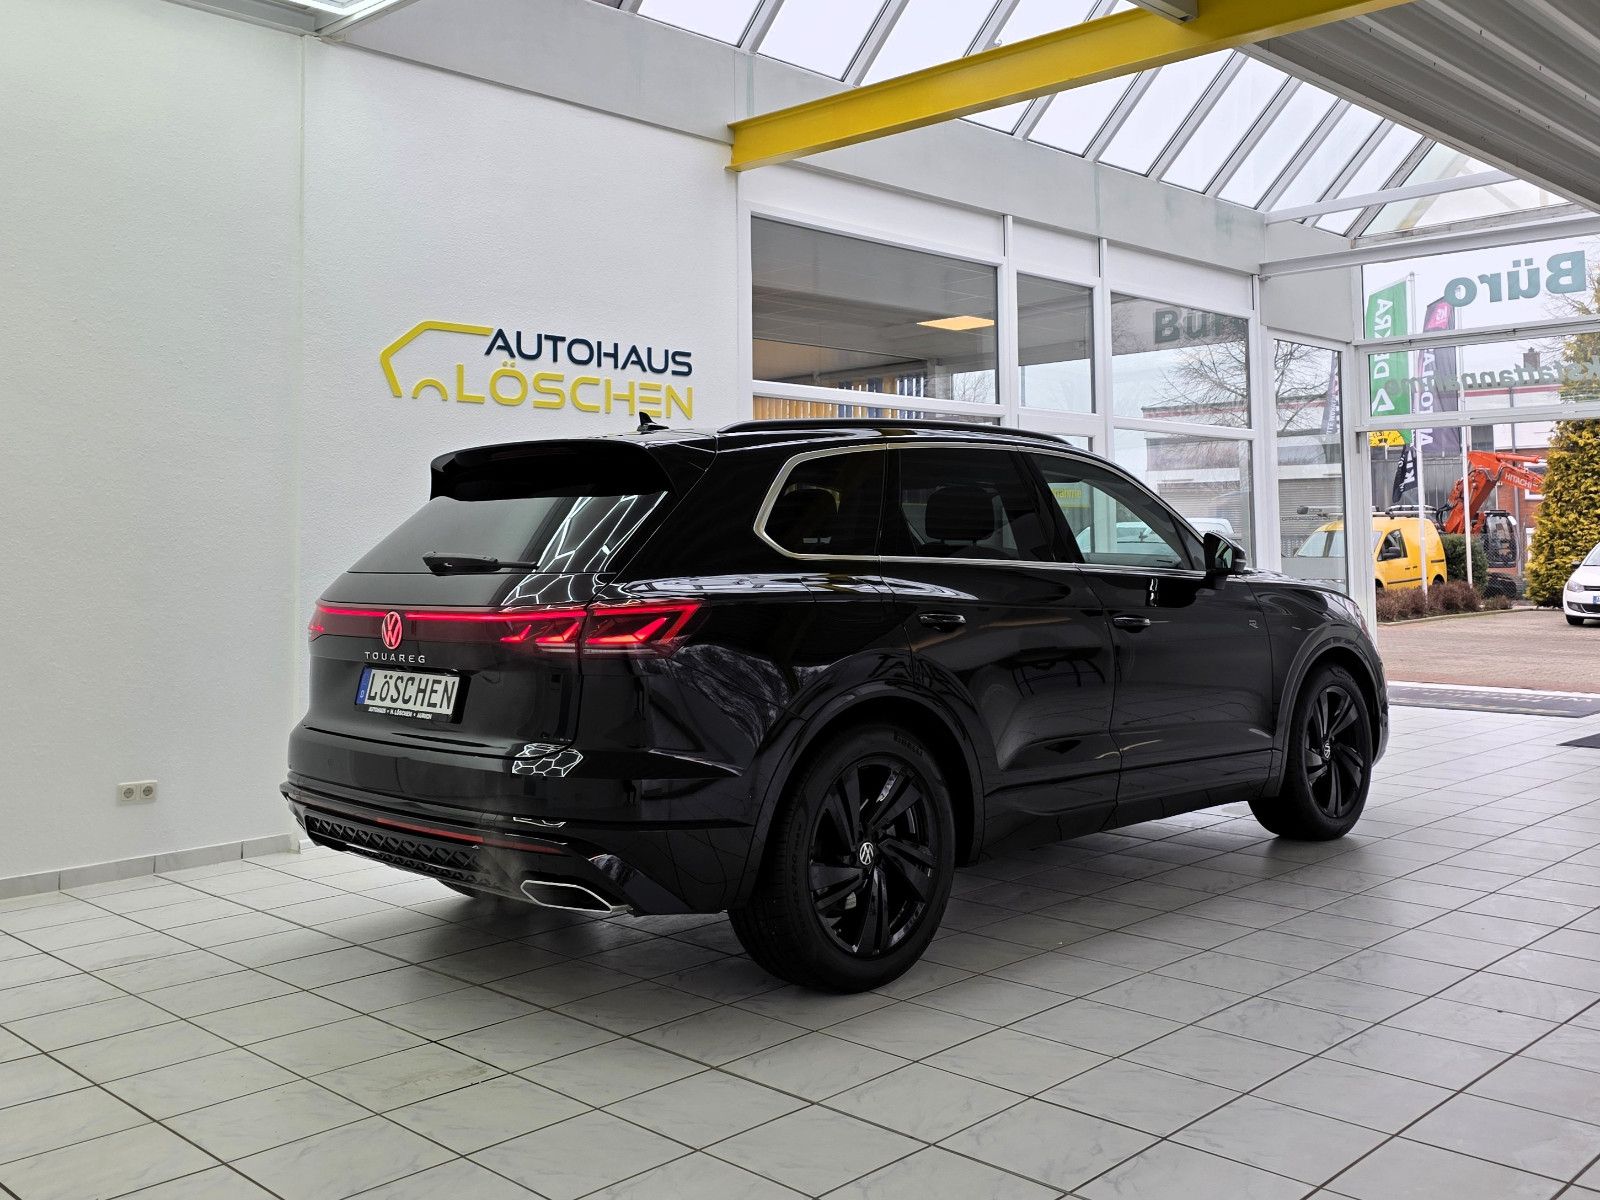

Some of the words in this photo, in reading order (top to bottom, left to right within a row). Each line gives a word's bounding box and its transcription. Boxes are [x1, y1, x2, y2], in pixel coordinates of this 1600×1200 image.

[484, 328, 693, 377] AUTOHAUS
[456, 360, 693, 420] LÖSCHEN
[1504, 473, 1532, 489] HITACHI
[365, 651, 426, 664] TOUAREG
